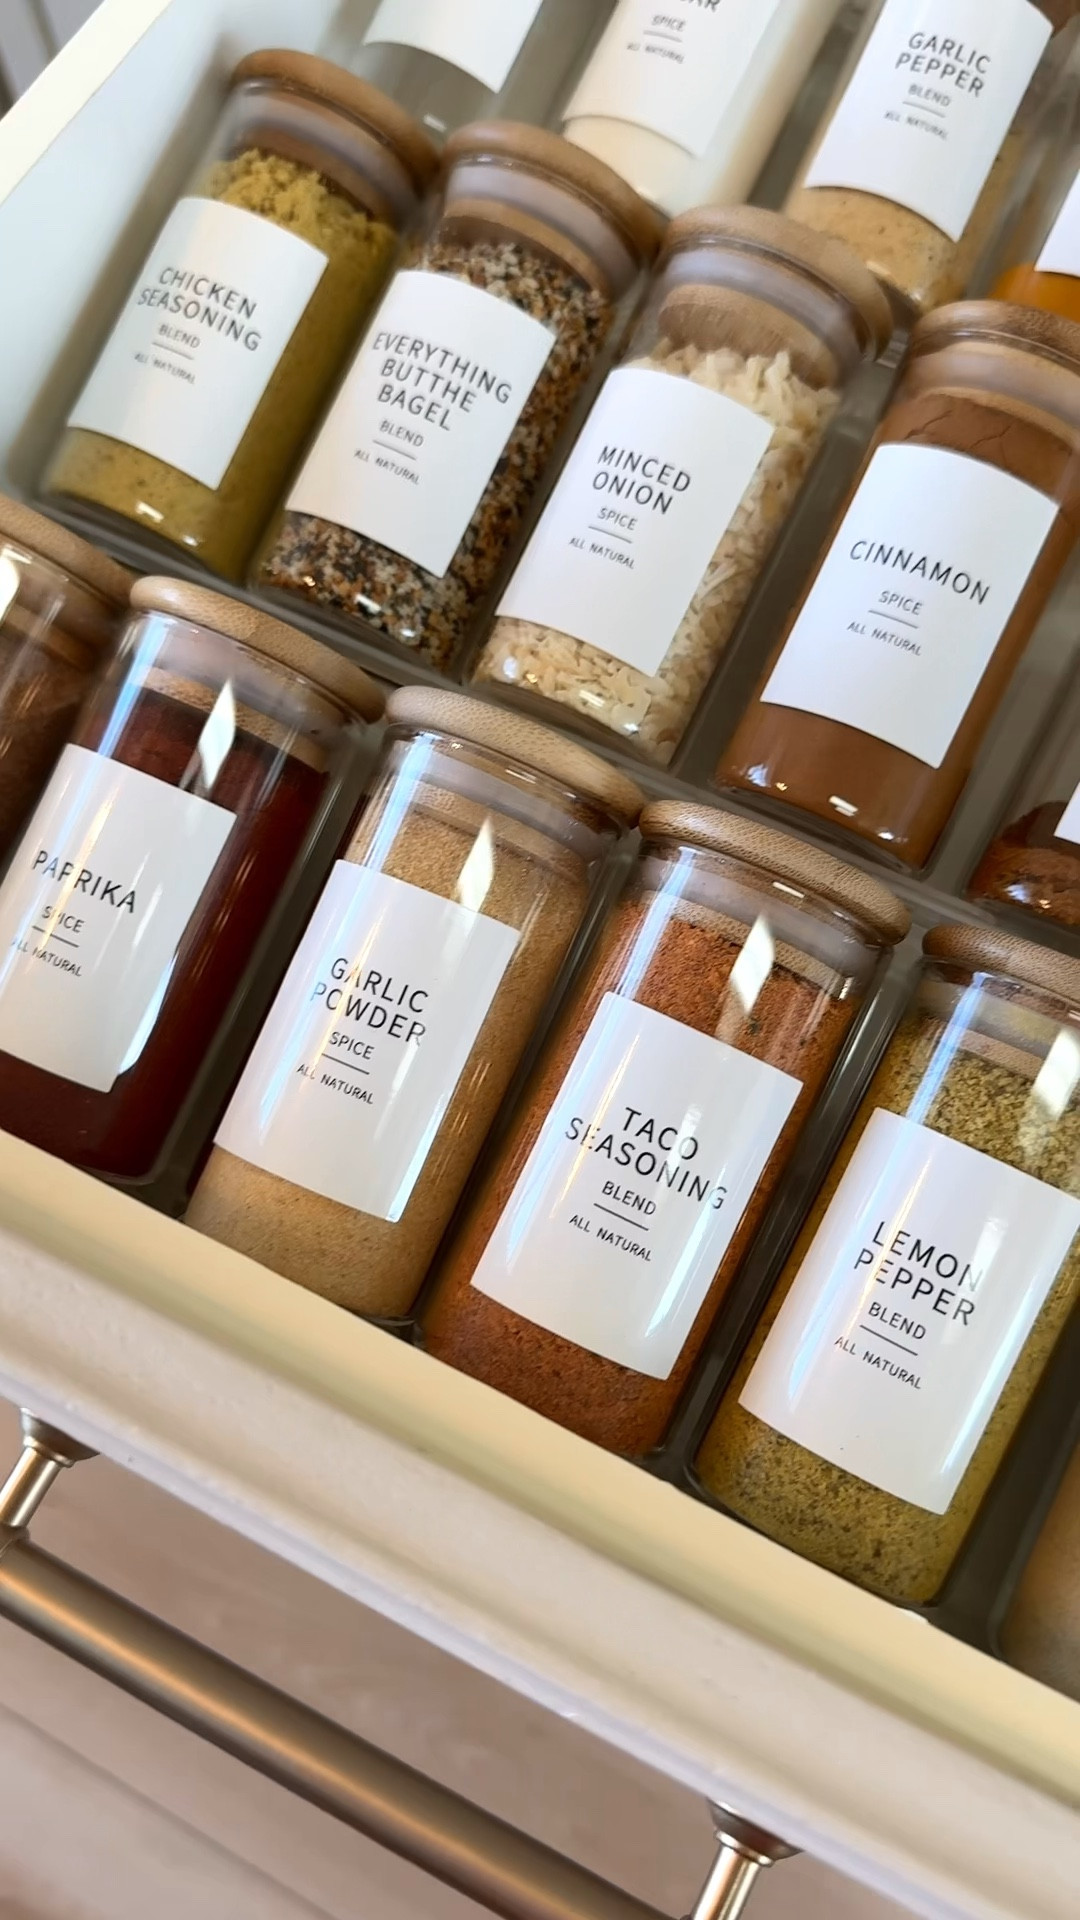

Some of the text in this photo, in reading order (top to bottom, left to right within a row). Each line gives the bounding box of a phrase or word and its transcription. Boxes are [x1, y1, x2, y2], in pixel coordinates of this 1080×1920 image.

[895, 53, 985, 98] PEPPER
[908, 32, 991, 74] GARLIC
[908, 83, 951, 107] BLEND
[906, 116, 949, 141] NATURAL
[159, 267, 257, 319] CHICKEN
[137, 287, 263, 352] SEASONING
[159, 324, 201, 349] BLEND
[152, 358, 197, 385] NATURAL
[372, 332, 513, 405] EVERYTHING
[380, 358, 477, 414] BUTTHE
[377, 383, 451, 432] BAGEL
[379, 420, 425, 448] BLEND
[353, 449, 421, 486] ALL NATURAL
[597, 445, 691, 493] MINCED
[592, 470, 674, 515] ONION
[597, 507, 639, 531] SPICE
[569, 537, 636, 570] ALL NATURAL
[849, 539, 991, 606] CINNAMON
[878, 590, 924, 616] SPICE
[847, 621, 922, 657] ALL NATURAL
[31, 850, 138, 914] PAPRIKA
[31, 945, 83, 977] NATURAL
[330, 957, 429, 1013] GARLIC
[310, 981, 426, 1047] POWDER
[328, 1031, 376, 1061] SPICE
[296, 1063, 375, 1105] ALL NATURAL
[624, 1106, 698, 1161] TACO
[564, 1117, 728, 1210] SEASONING
[601, 1180, 658, 1216] BLEND
[569, 1214, 652, 1263] ALL NATURAL
[871, 1221, 983, 1293] LEMON
[853, 1247, 976, 1327] PEPPER
[867, 1301, 928, 1341] BLEND
[834, 1336, 922, 1391] ALL NATURAL
